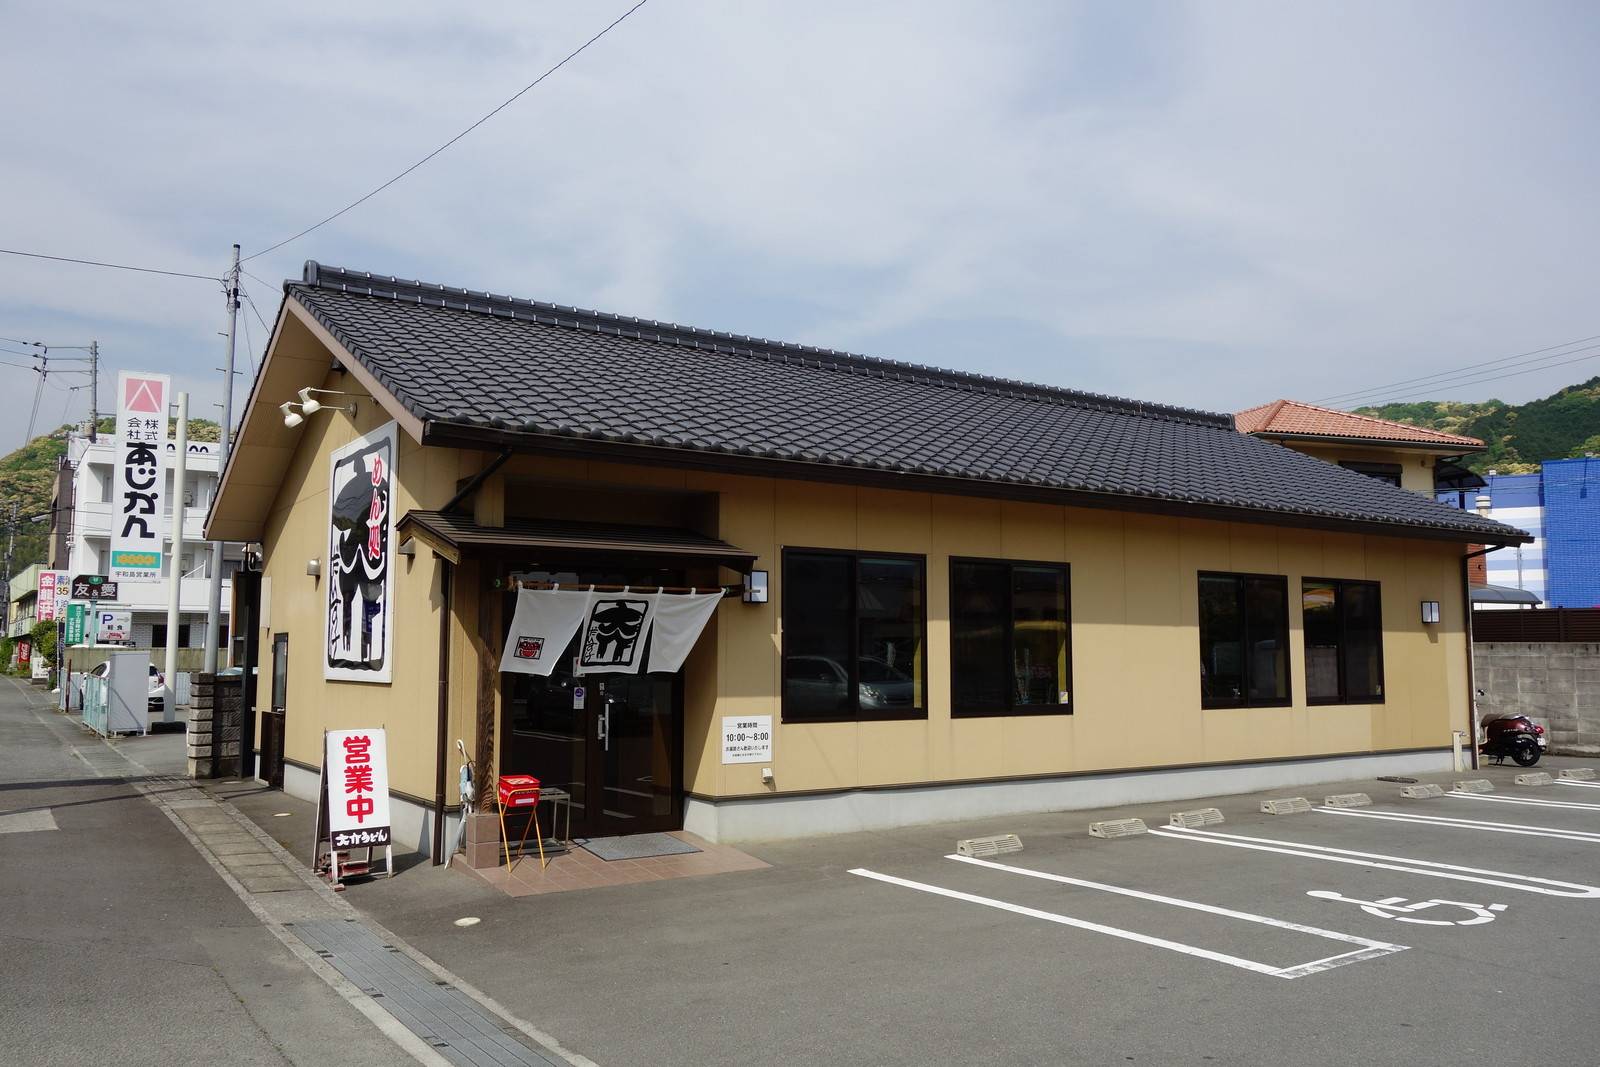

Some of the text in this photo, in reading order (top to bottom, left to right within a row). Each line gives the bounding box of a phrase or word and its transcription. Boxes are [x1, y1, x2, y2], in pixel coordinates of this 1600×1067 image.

[120, 441, 159, 539] あじかん
[102, 614, 114, 624] P
[343, 735, 374, 824] 営業中
[335, 829, 388, 847] 大介うどん
